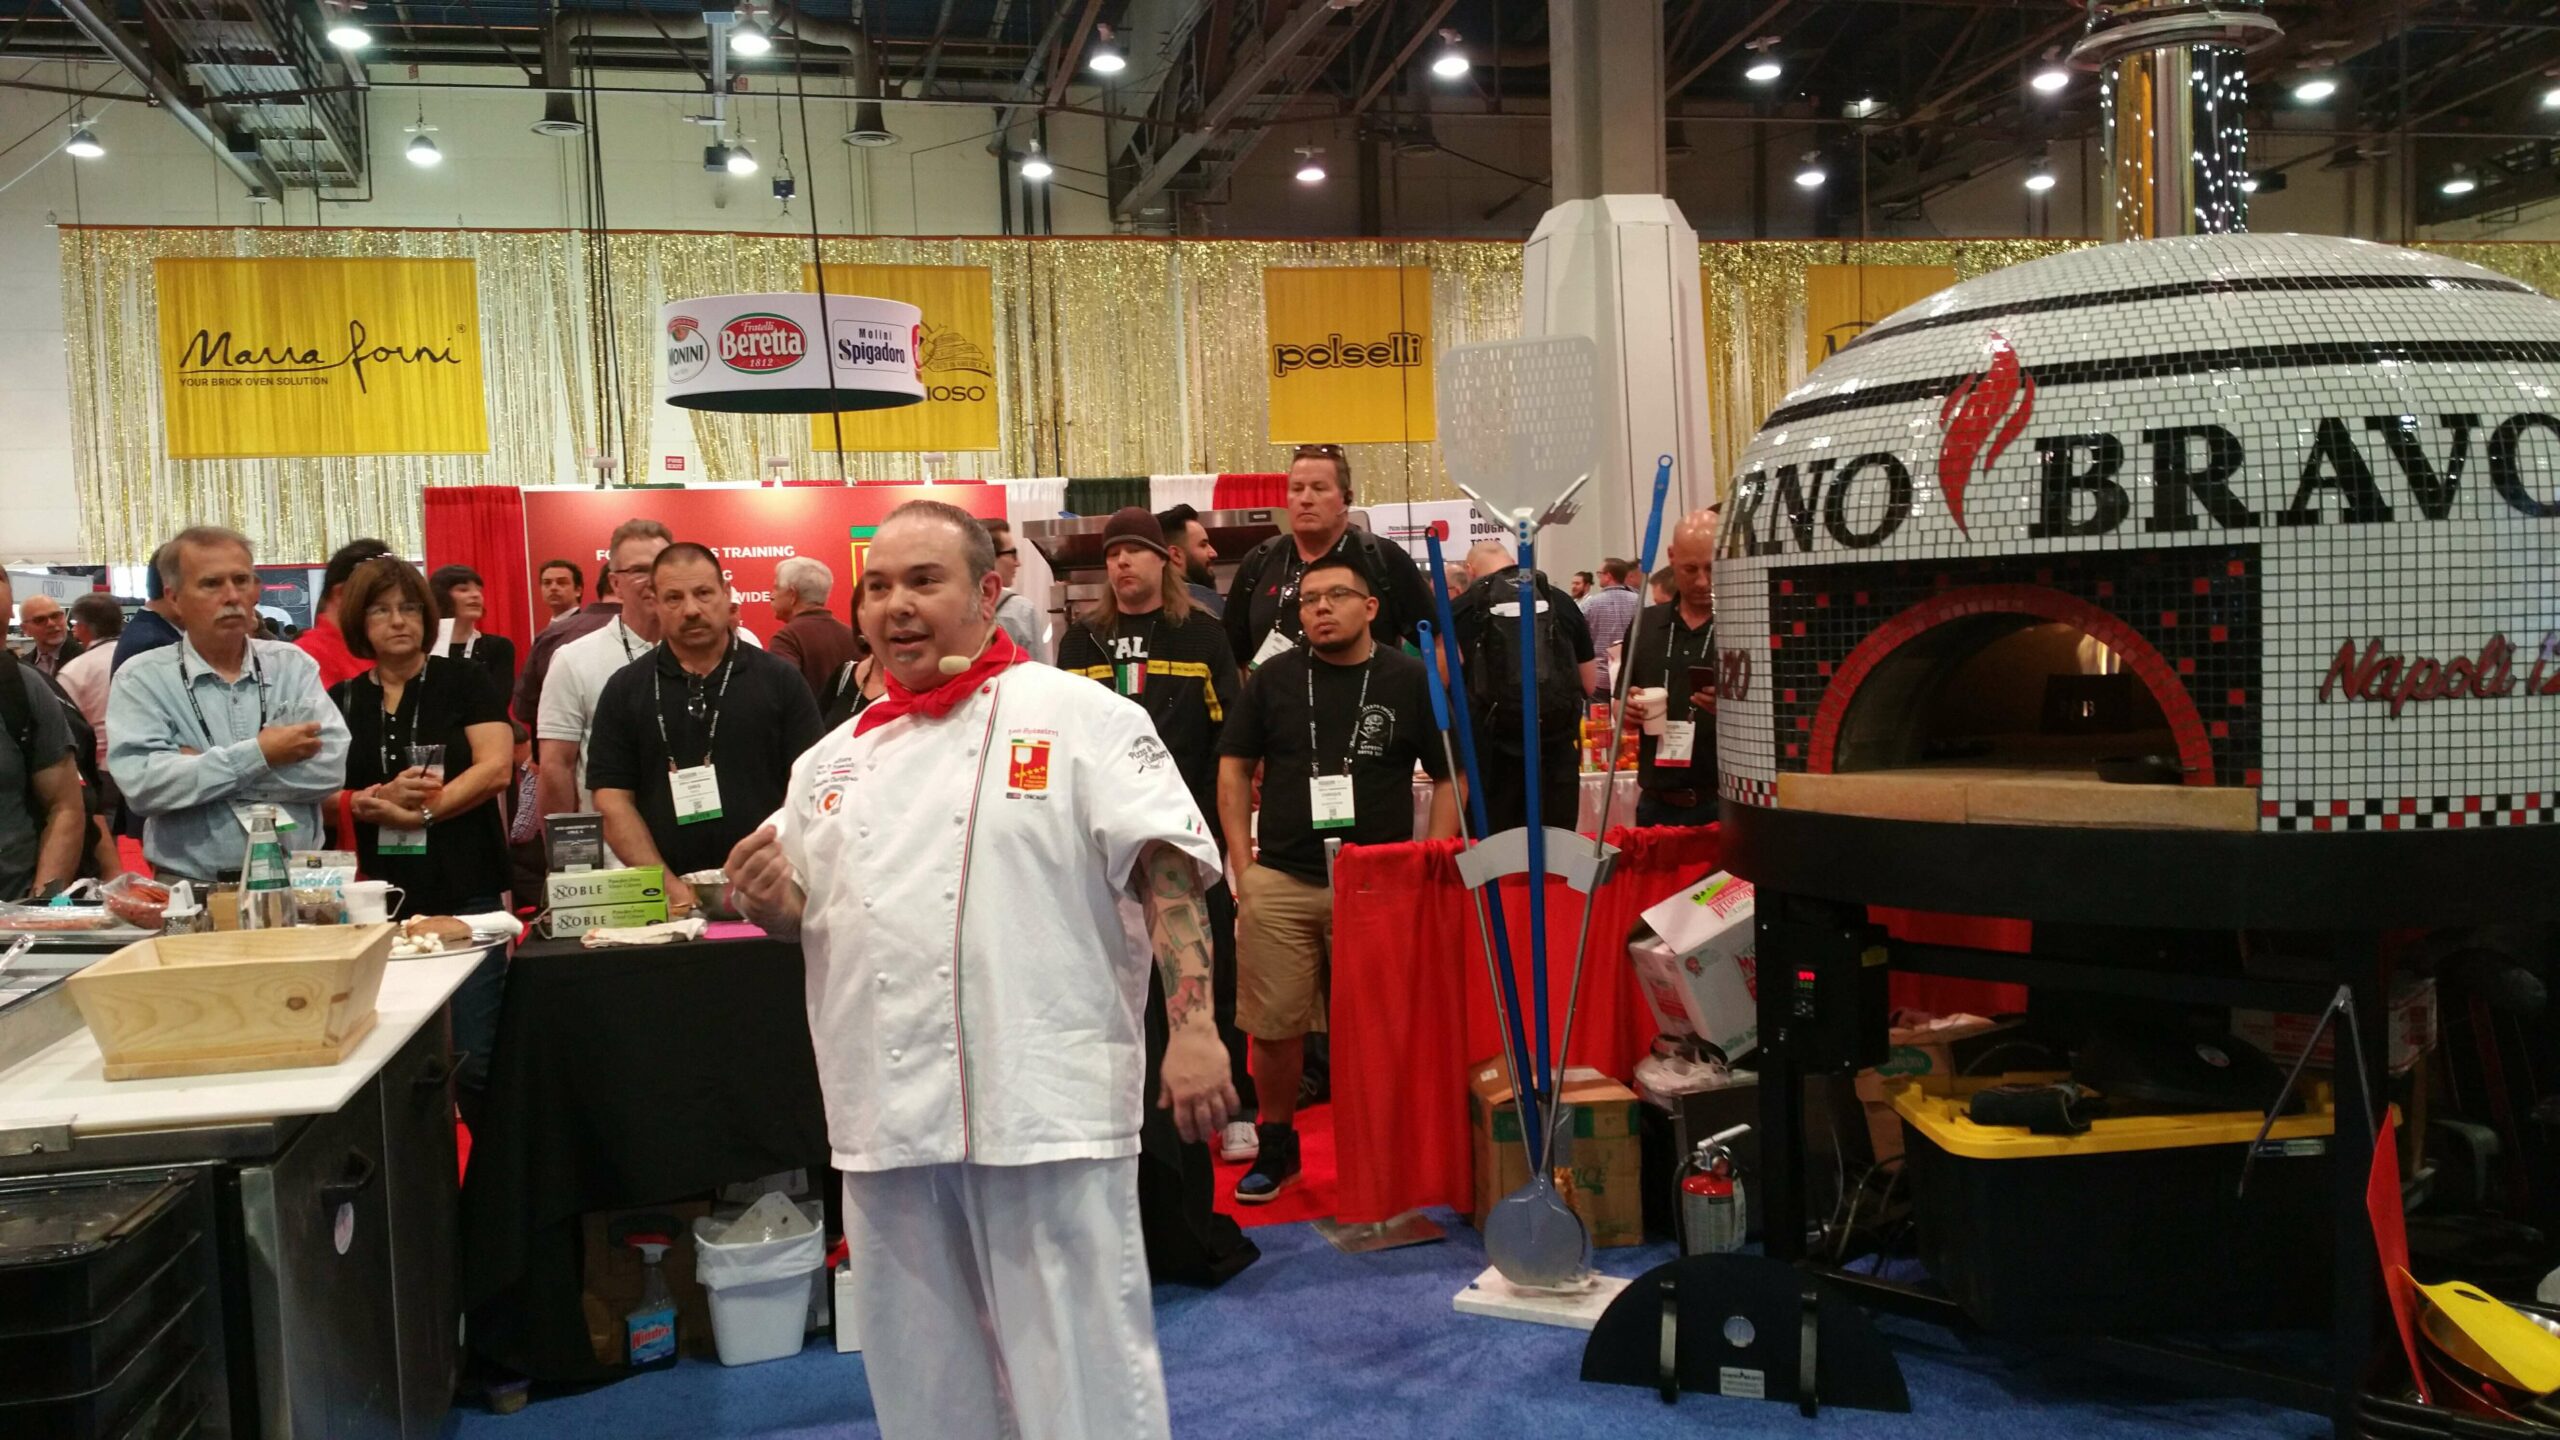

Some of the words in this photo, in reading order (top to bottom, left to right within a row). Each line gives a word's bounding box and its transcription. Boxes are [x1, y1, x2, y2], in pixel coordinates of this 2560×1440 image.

[741, 321, 776, 332] Fratelli
[859, 328, 893, 341] Molini
[719, 327, 806, 360] Beretta
[838, 338, 905, 365] Spigadoro
[346, 319, 462, 394] forni
[750, 358, 774, 368] 1812
[1273, 333, 1422, 378] polselli
[179, 378, 209, 387] YOUR
[211, 378, 243, 387] BRICK
[246, 378, 274, 386] OVEN
[276, 377, 329, 386] SOLUTION
[926, 386, 986, 402] IOSO
[2028, 412, 2560, 539] BRAVO
[1715, 451, 1913, 560] RNO
[722, 545, 796, 559] TRAINING
[2318, 631, 2517, 721] Napoli
[553, 885, 603, 899] NOBLE
[557, 914, 607, 929] NOBLE
[631, 1326, 670, 1350] Windex
